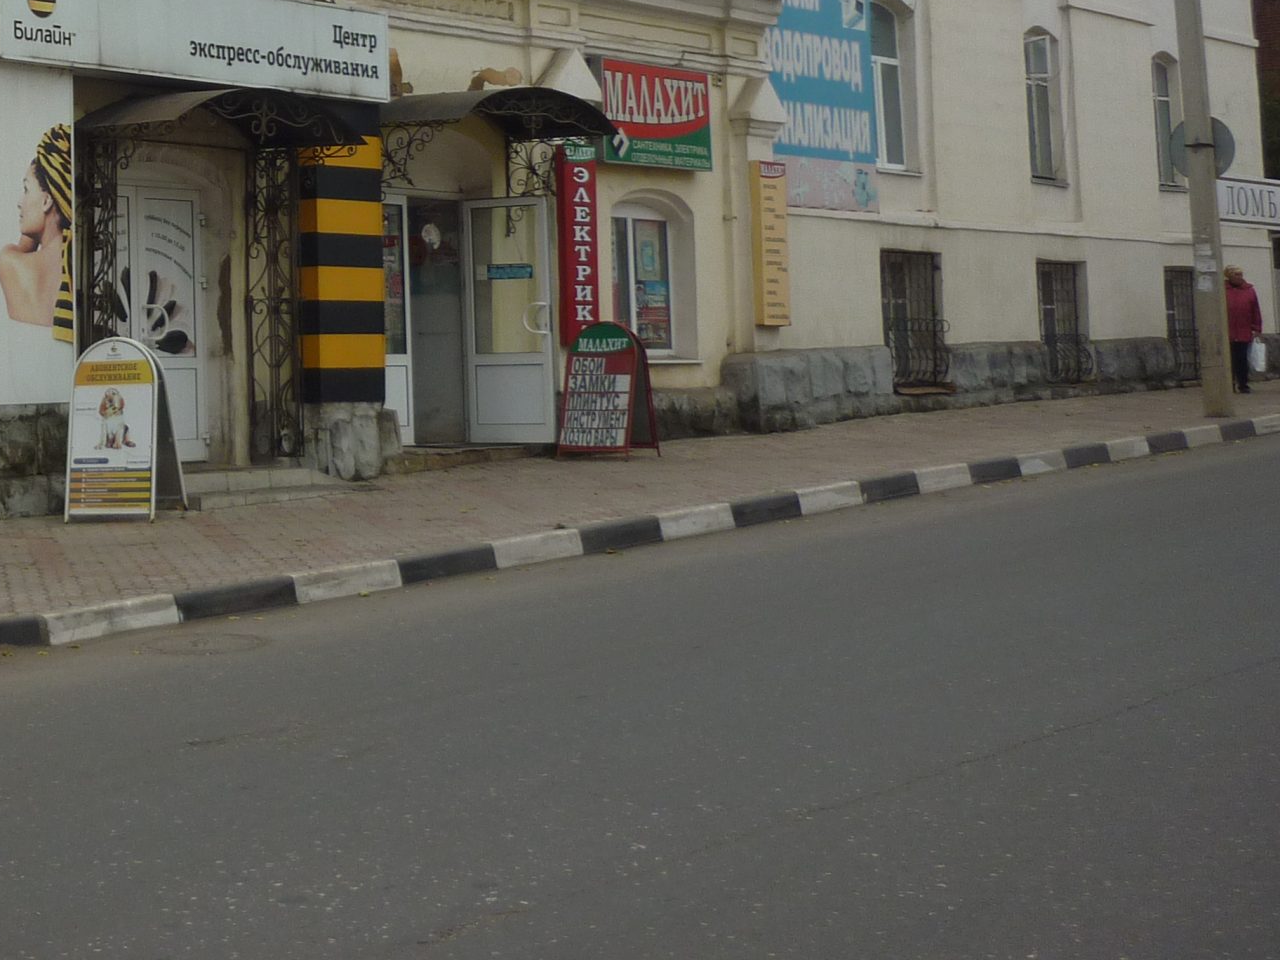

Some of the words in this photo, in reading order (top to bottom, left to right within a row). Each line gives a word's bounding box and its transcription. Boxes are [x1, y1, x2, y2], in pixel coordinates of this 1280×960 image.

[333, 24, 377, 53] Центр
[189, 40, 380, 80] экспресс-обслуживания
[604, 69, 706, 125] МАЛАХИТ
[776, 100, 870, 160] НАЛИЗАЦИЯ
[1225, 185, 1280, 219] ЛОМБ
[572, 167, 594, 331] ЭЛЕКТРИК
[577, 338, 629, 352] МАЛАХИТ
[573, 358, 604, 373] ОБОИ
[570, 375, 616, 391] ЗАМКИ
